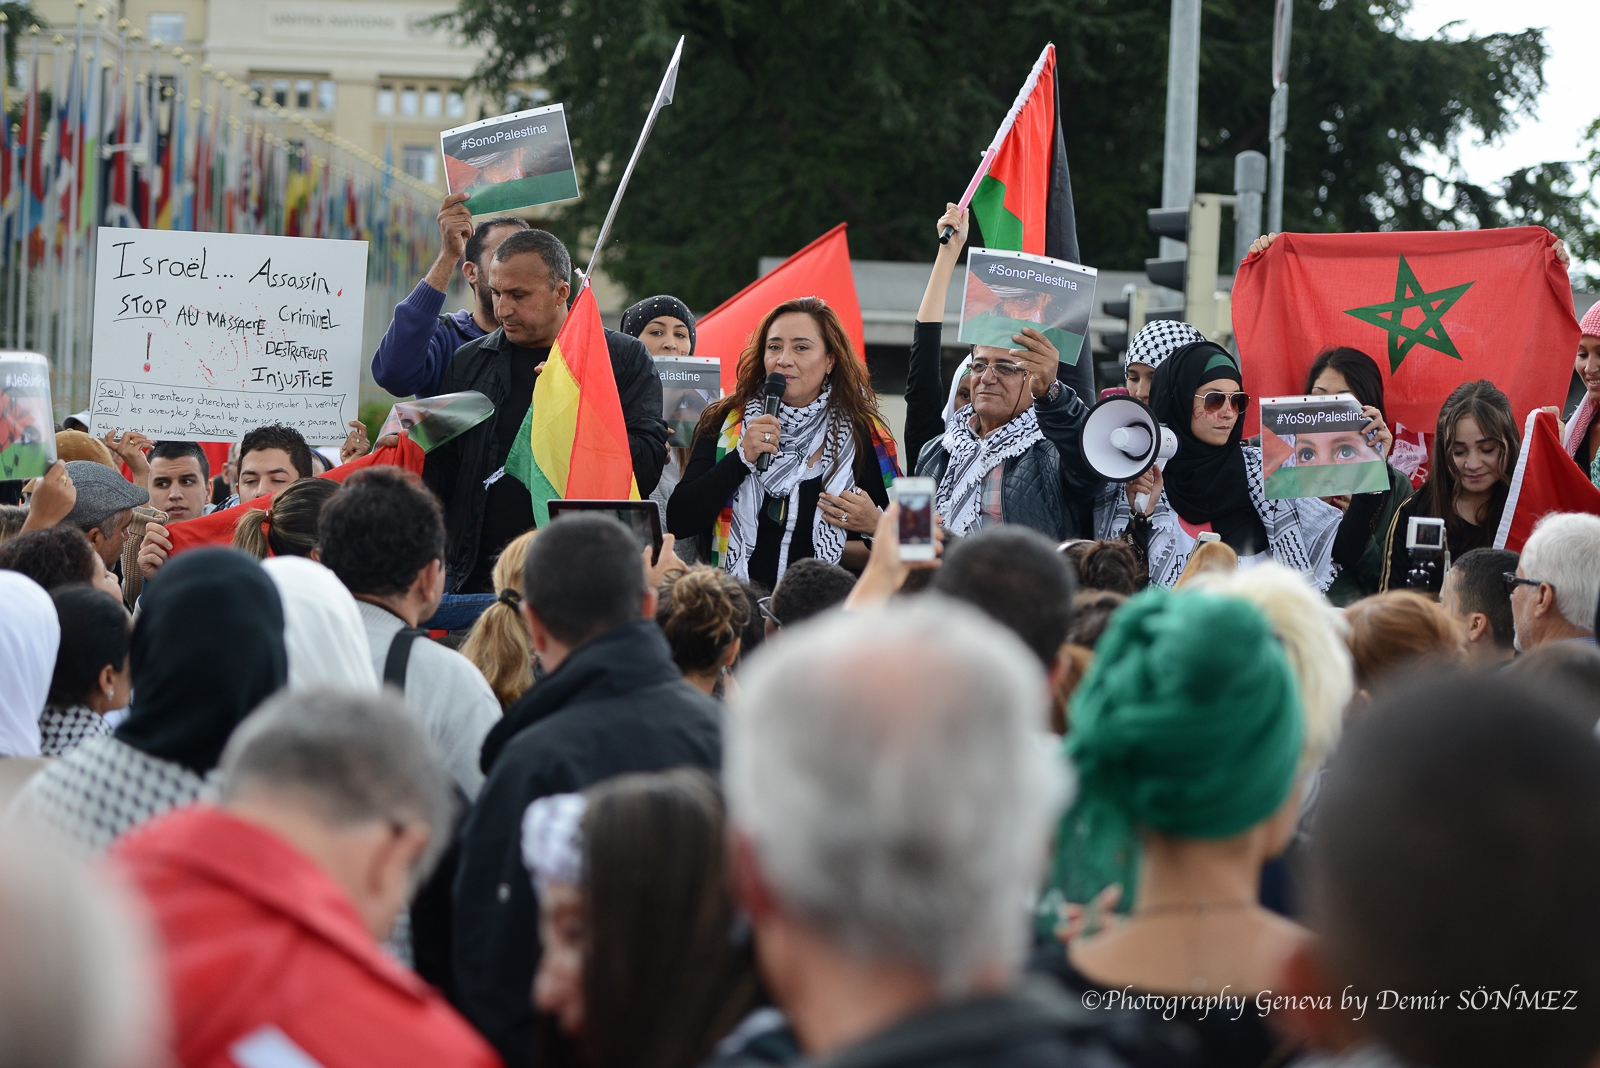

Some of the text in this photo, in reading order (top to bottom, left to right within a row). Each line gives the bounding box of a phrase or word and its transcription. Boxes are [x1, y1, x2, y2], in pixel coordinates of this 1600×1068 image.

[460, 123, 548, 151] #SonoPalestina
[988, 263, 1078, 291] #SonoPalestina
[117, 294, 167, 316] STOP
[176, 305, 199, 326] AU
[658, 371, 700, 381] alastine
[132, 385, 145, 399] les
[151, 390, 194, 404] menteurs
[197, 393, 240, 409] cherchent
[256, 398, 300, 411] dissimuler
[304, 397, 312, 409] la
[130, 402, 142, 414] les
[148, 405, 189, 418] aveugles
[192, 408, 225, 420] ferment
[228, 411, 239, 422] les
[1276, 410, 1366, 426] #YoSoyPalestina
[187, 421, 237, 437] Palestine
